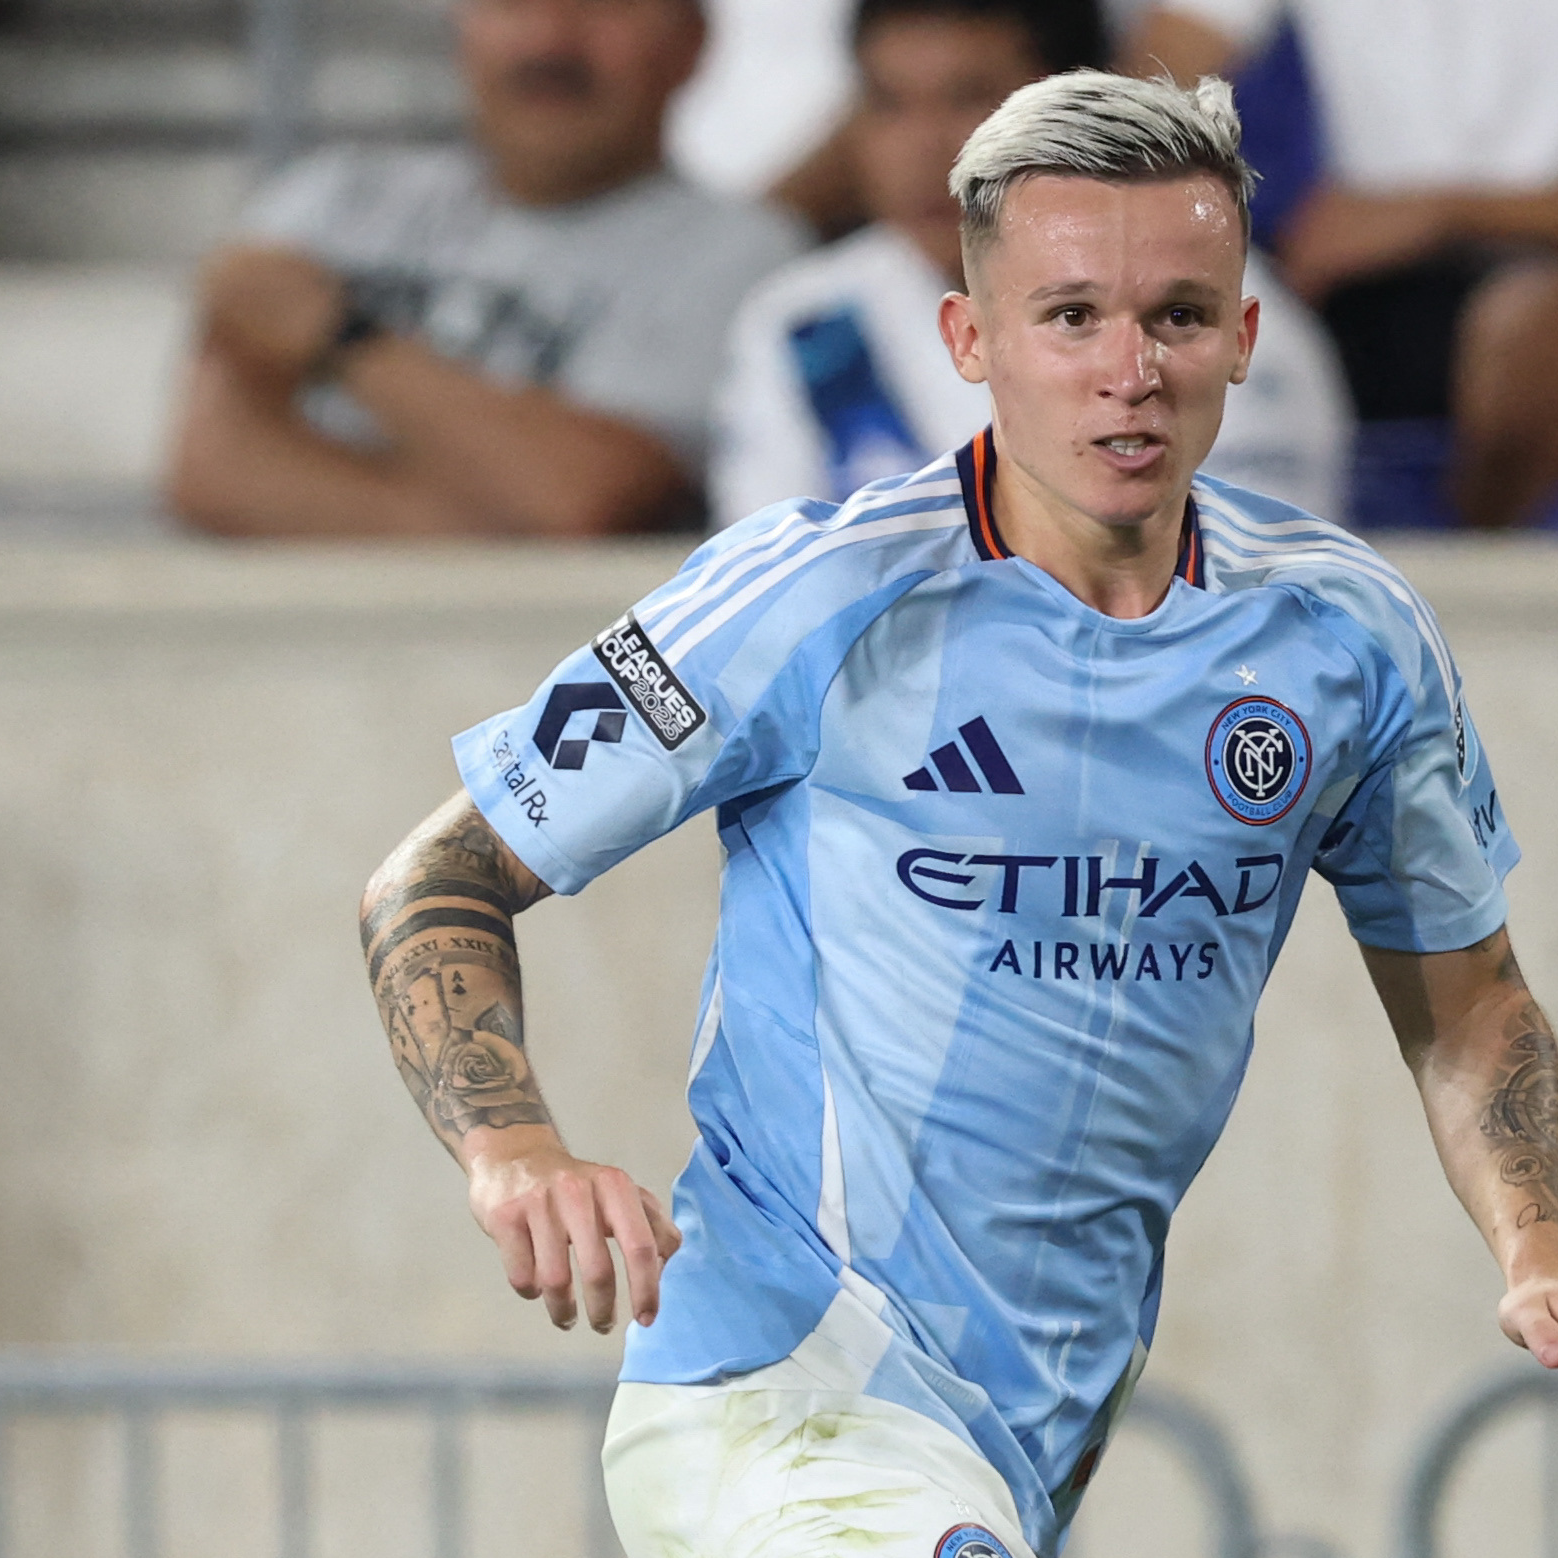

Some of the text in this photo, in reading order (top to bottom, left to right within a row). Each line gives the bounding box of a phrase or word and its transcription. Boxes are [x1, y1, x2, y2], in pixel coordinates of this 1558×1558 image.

[615, 624, 697, 729] LEAGUES
[1221, 704, 1292, 731] NEW YORK CITY
[493, 730, 549, 828] Capital Rx
[1226, 793, 1271, 817] FOOTBALL
[896, 848, 1284, 918] ETIHAD
[989, 939, 1219, 982] AIRWAYS
